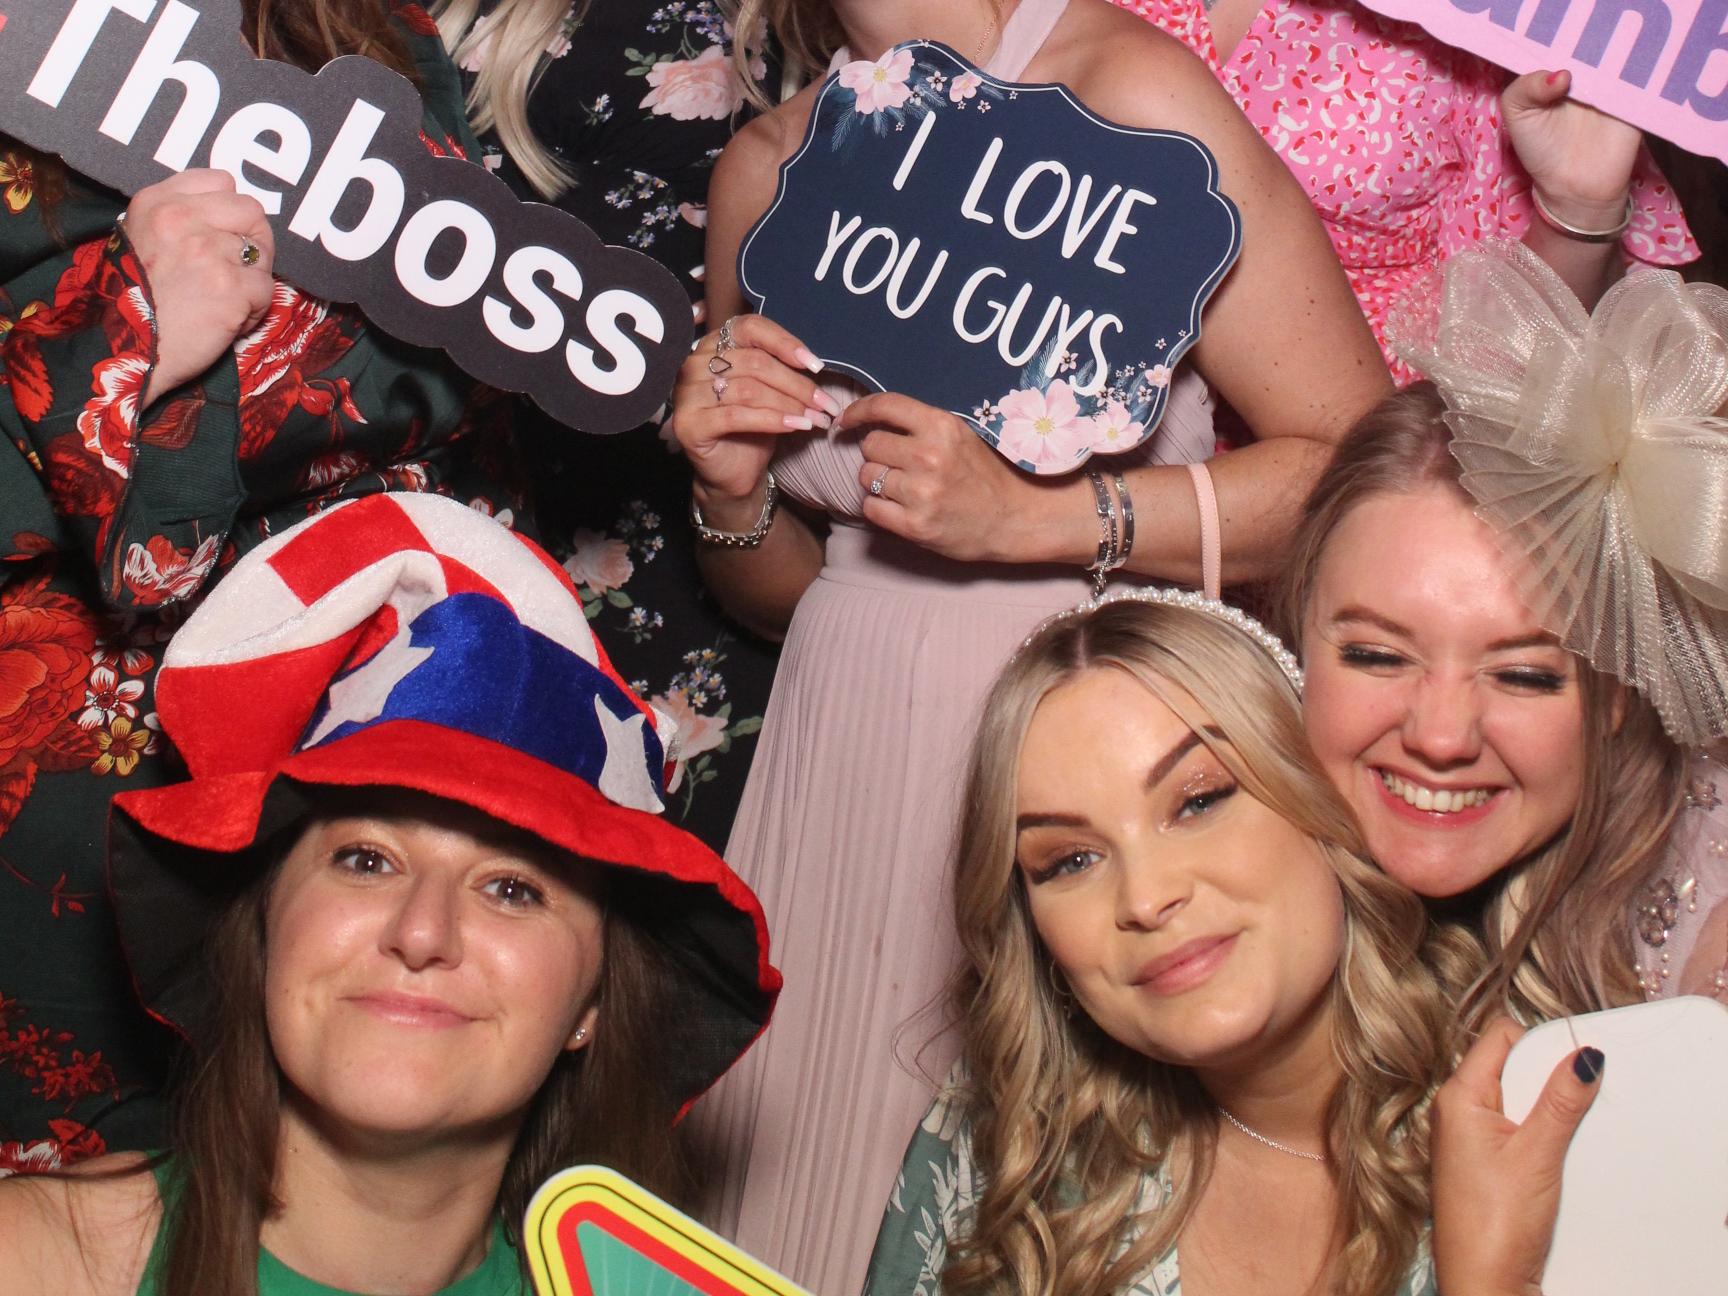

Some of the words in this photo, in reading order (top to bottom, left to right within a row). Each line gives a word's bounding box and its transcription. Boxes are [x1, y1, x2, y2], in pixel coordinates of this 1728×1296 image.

[892, 110, 937, 191] I
[961, 137, 1157, 274] LOVE
[814, 210, 949, 319] YOU
[952, 266, 1124, 397] GUYS
